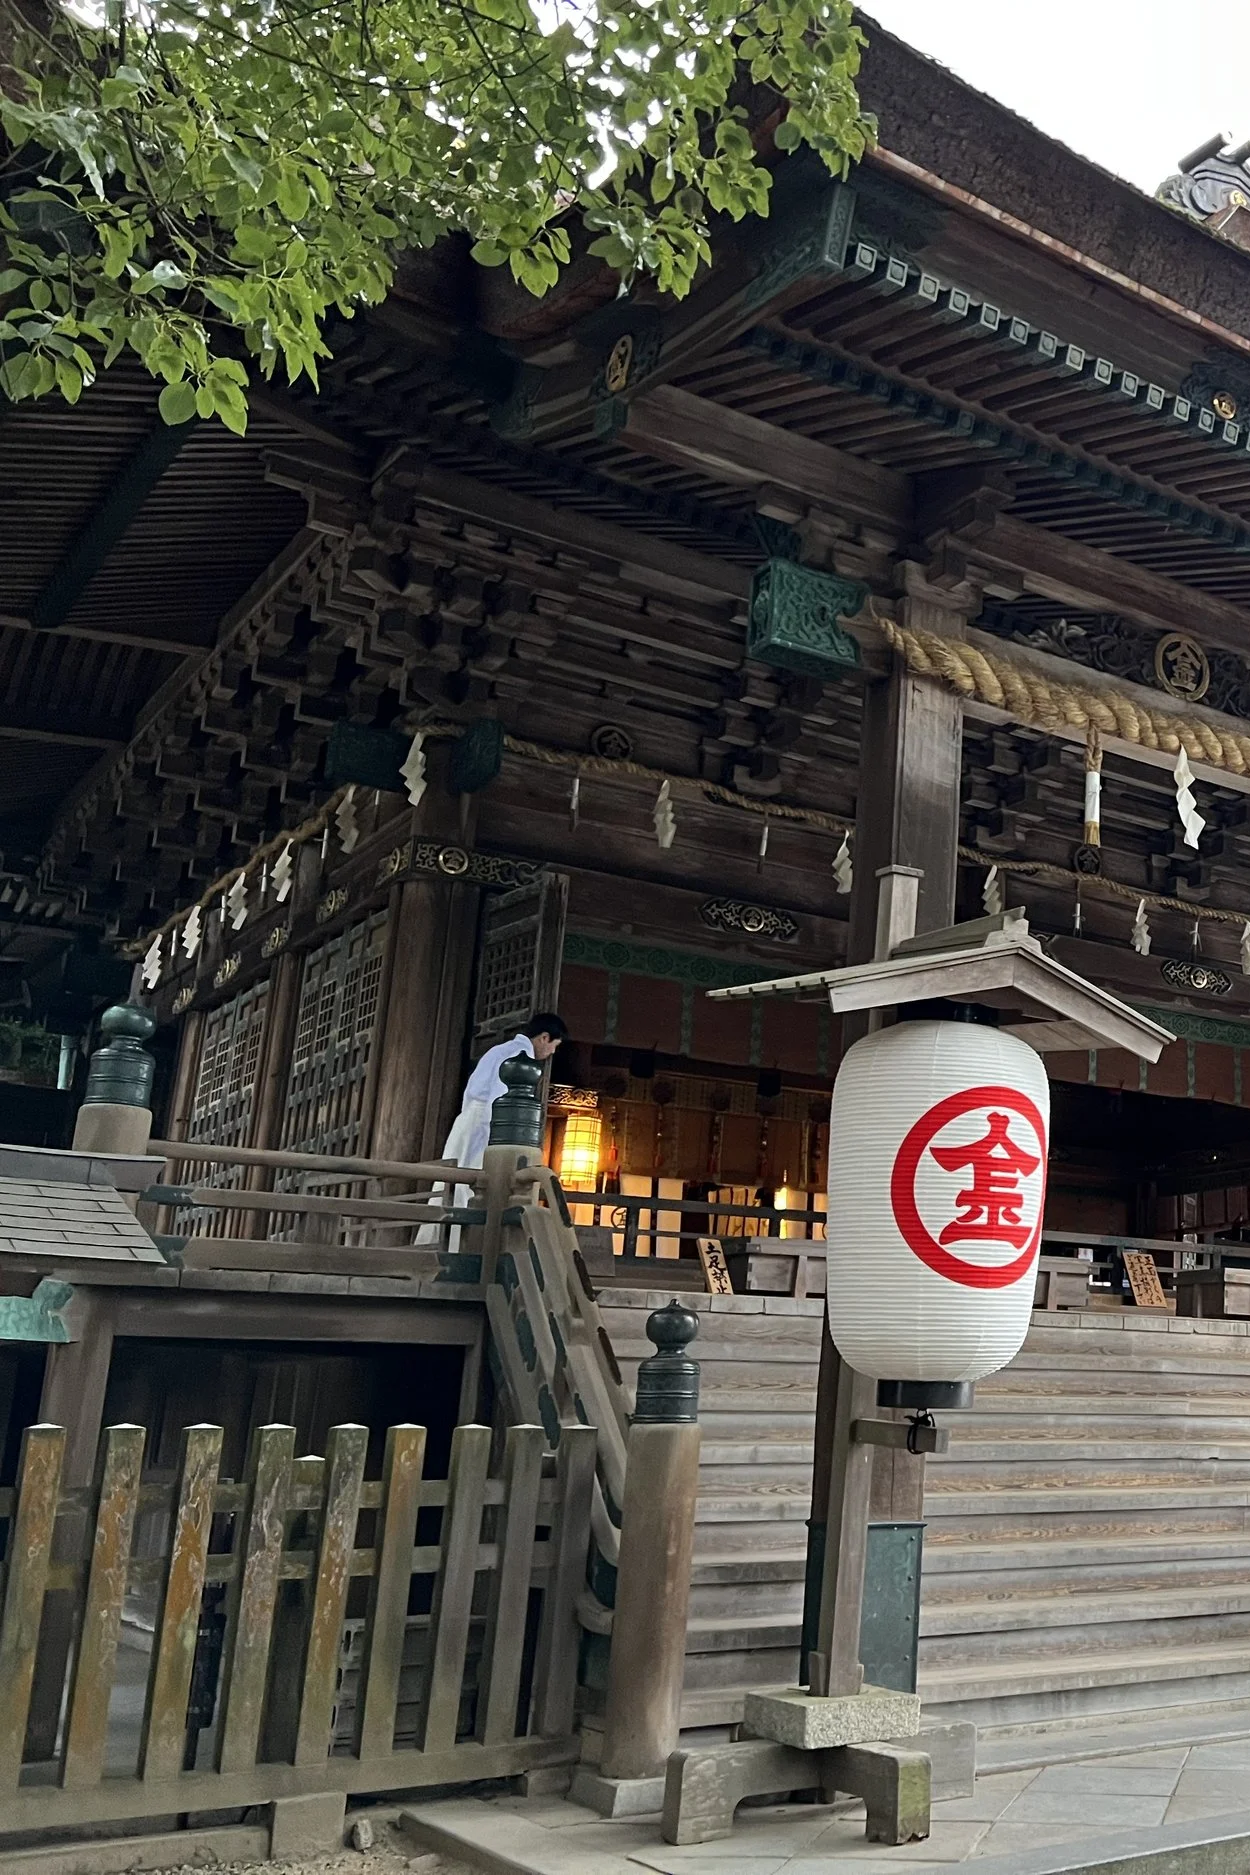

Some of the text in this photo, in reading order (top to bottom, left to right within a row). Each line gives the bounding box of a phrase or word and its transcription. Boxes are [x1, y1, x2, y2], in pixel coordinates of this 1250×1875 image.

[1166, 641, 1201, 692] 金
[929, 1111, 1041, 1250] 金
[705, 1241, 732, 1295] 土足禁止
